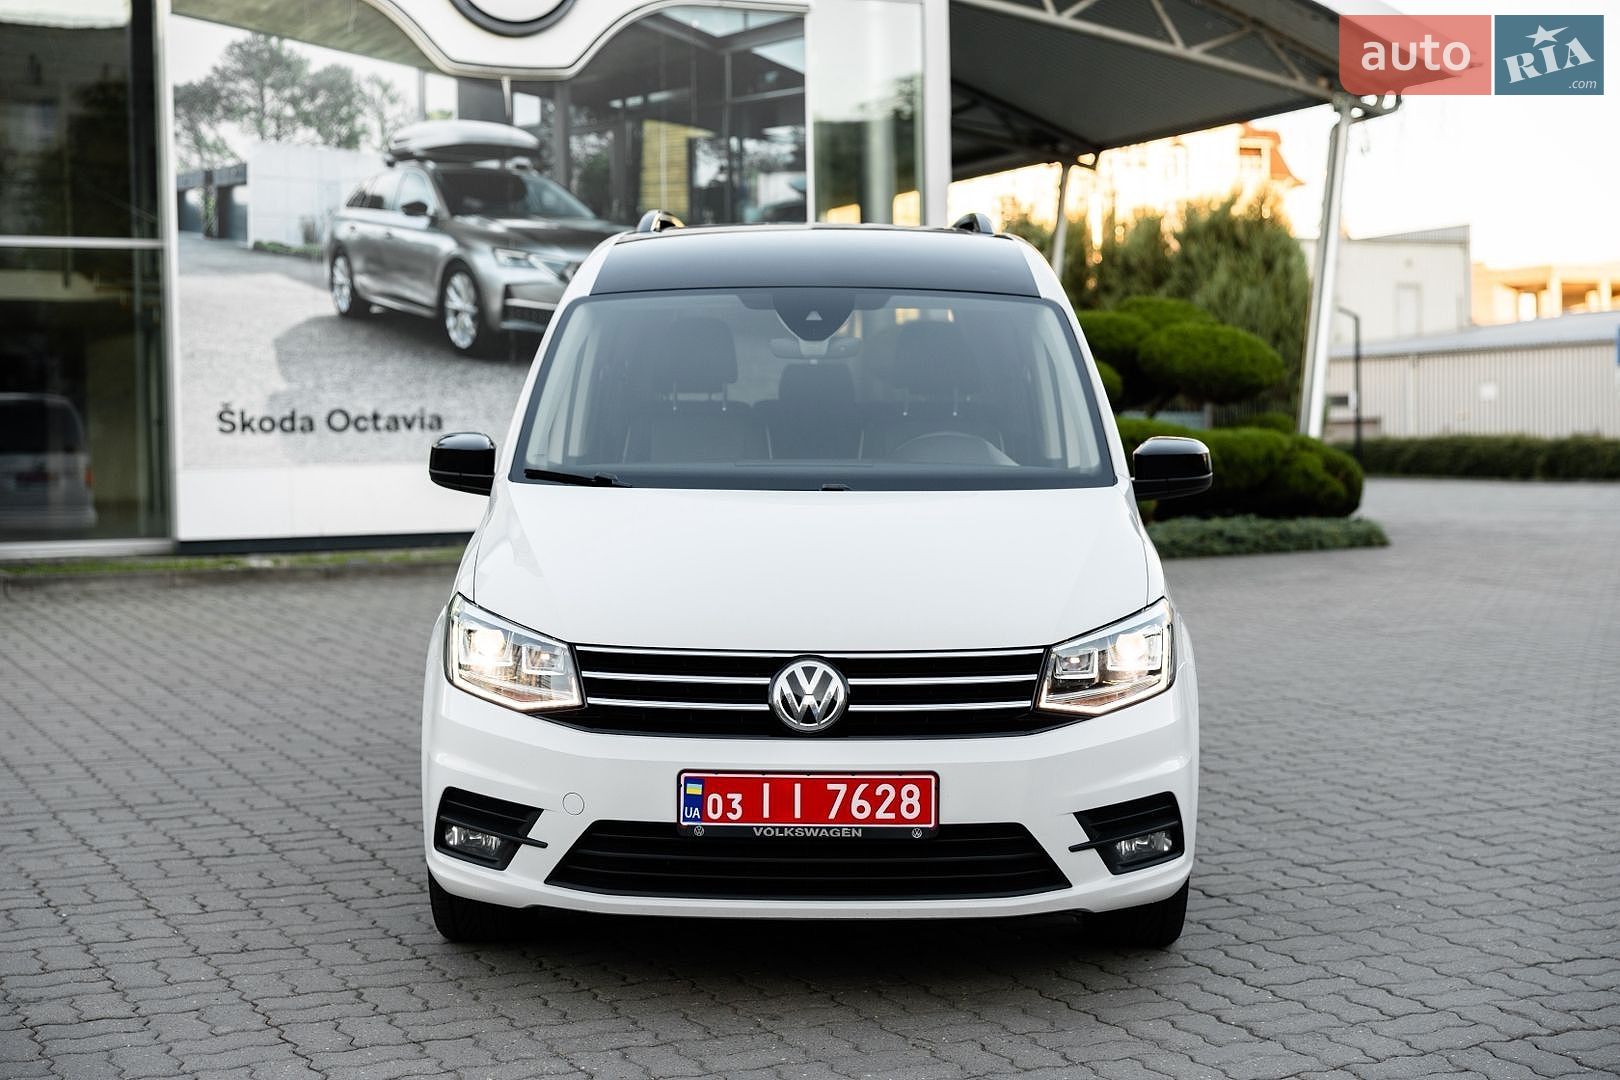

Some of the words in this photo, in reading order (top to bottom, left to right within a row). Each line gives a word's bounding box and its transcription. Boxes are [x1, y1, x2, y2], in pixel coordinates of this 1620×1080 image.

[218, 402, 314, 433] Škoda
[327, 408, 443, 433] Octavia
[706, 793, 743, 820] 03
[826, 783, 921, 820] 7628
[684, 807, 700, 819] UA
[753, 826, 862, 838] VOLKSWAGEN
